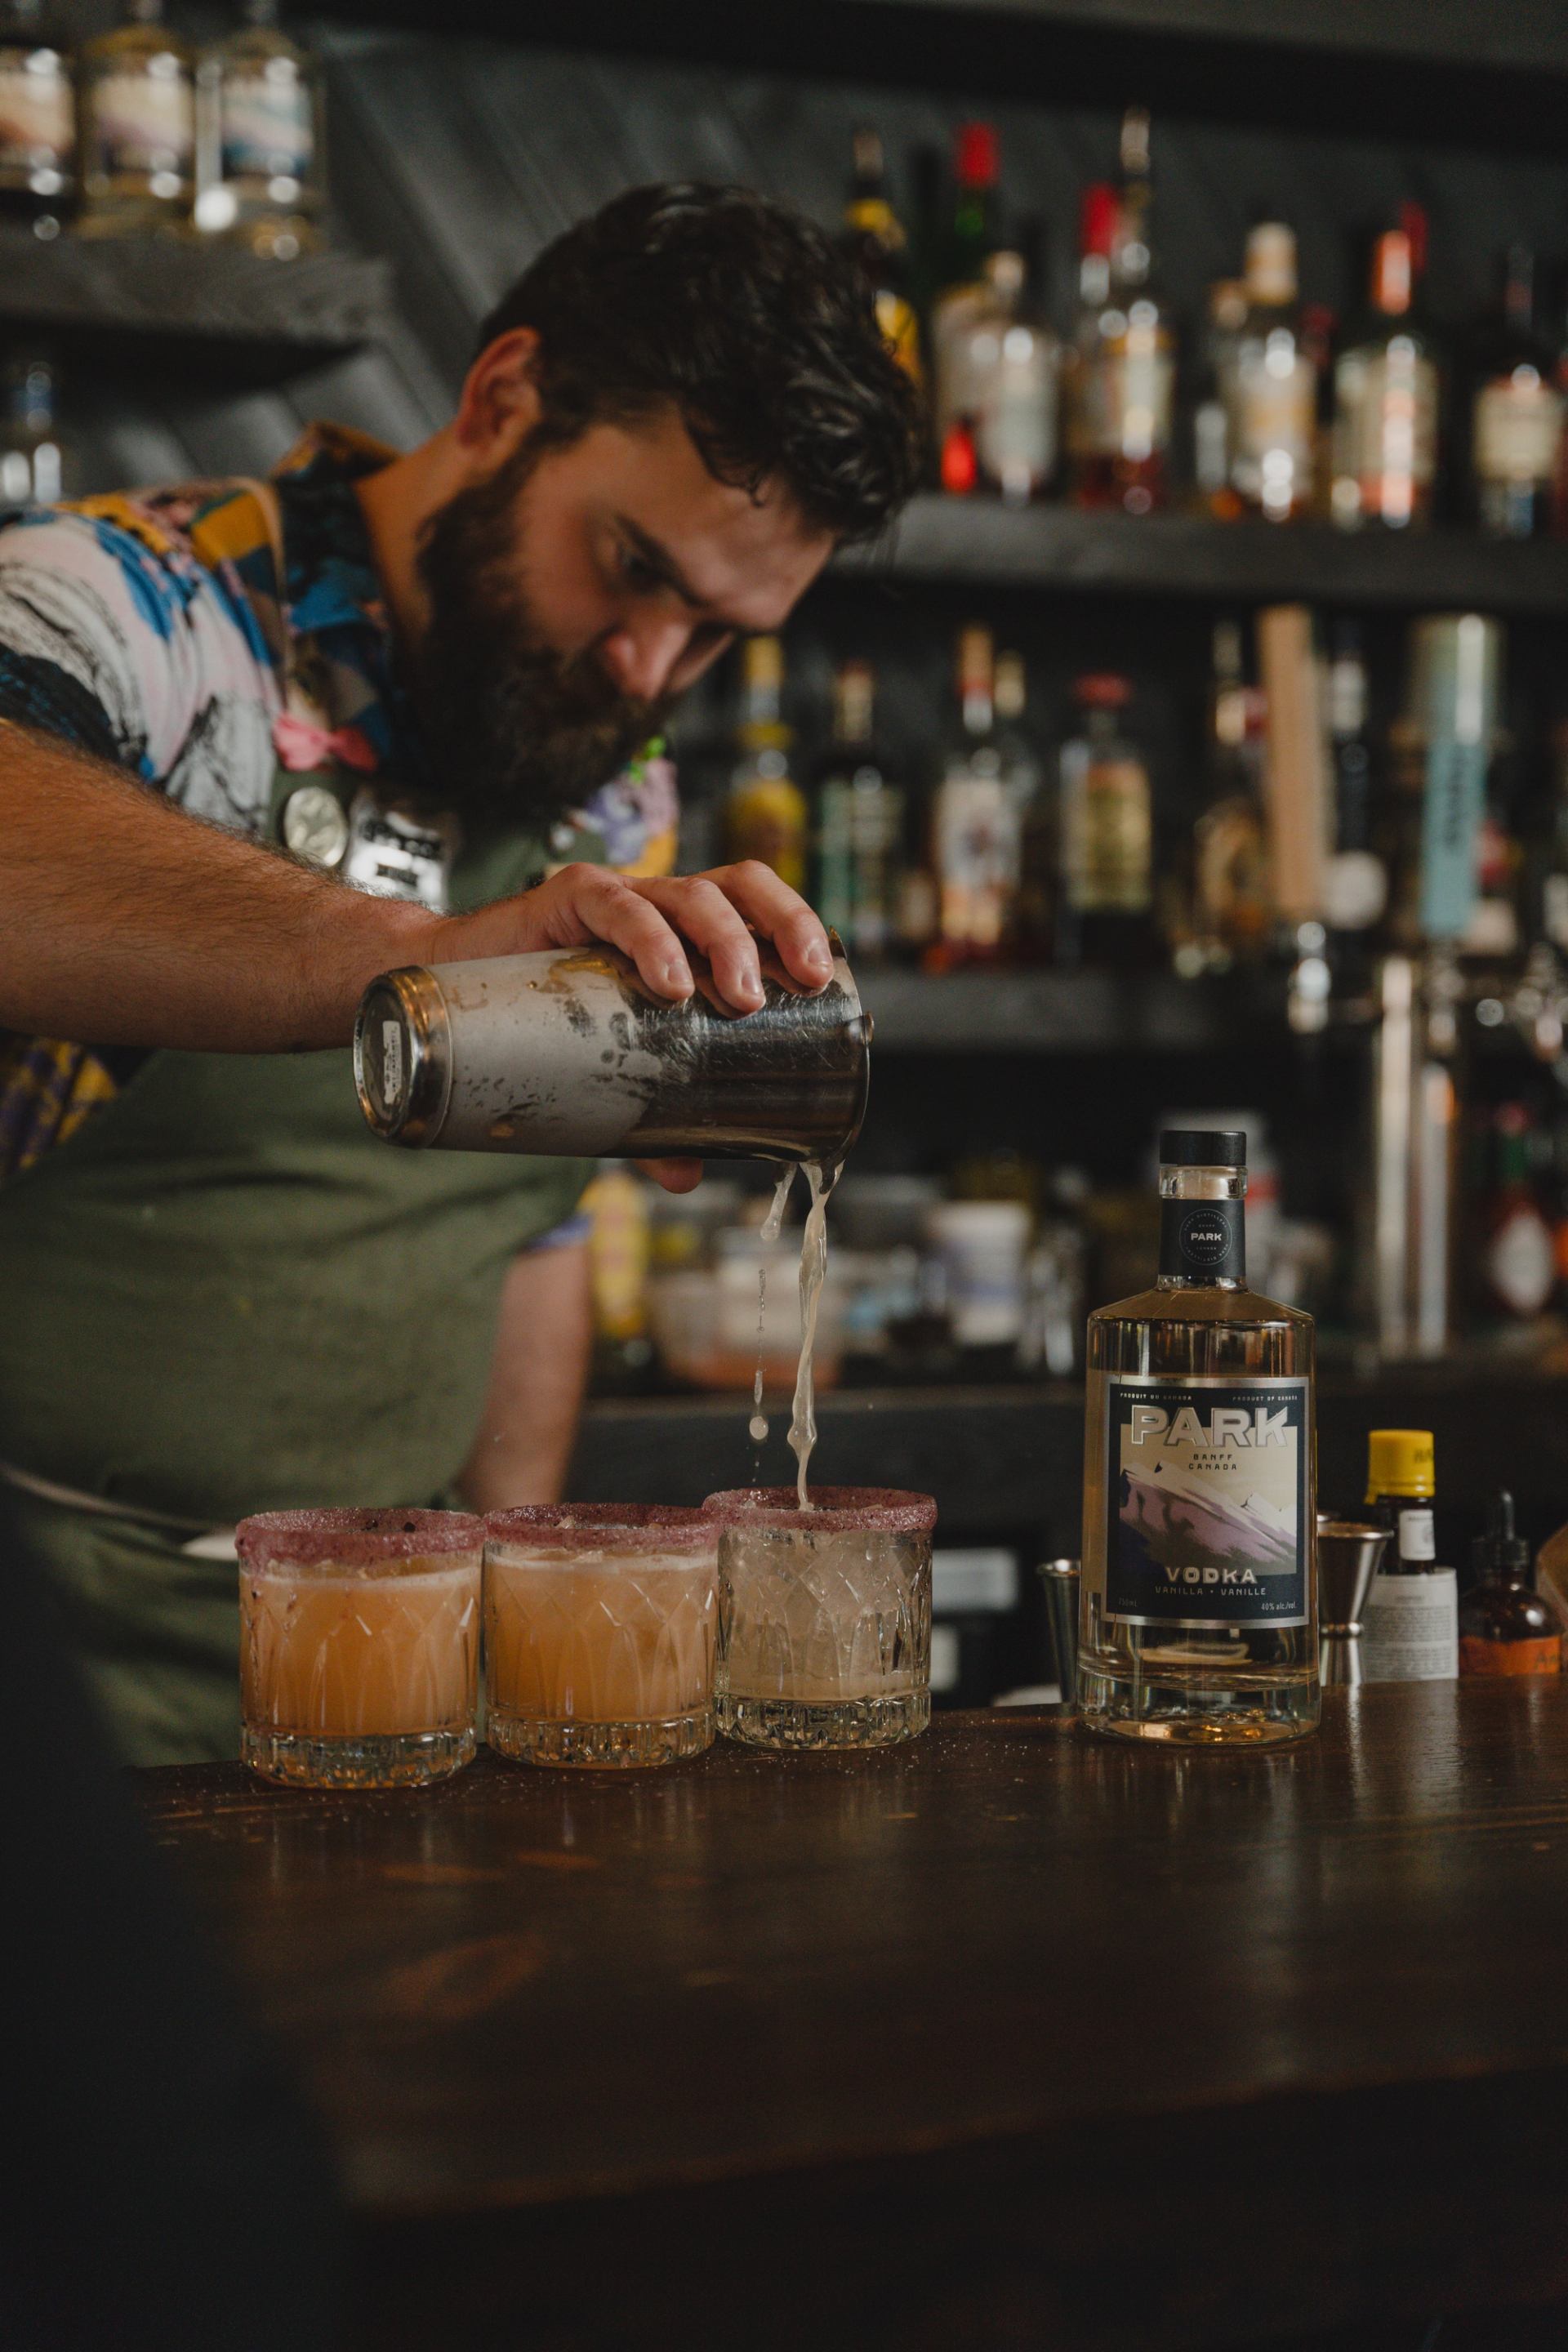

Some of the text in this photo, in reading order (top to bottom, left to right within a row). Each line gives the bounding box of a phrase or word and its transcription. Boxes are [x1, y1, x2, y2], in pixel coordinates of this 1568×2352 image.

[1191, 1232, 1222, 1241] PARK
[1131, 1404, 1289, 1448] PARK
[1165, 1566, 1258, 1584] VODKA
[1155, 1586, 1266, 1596] VANILLA VANILLE
